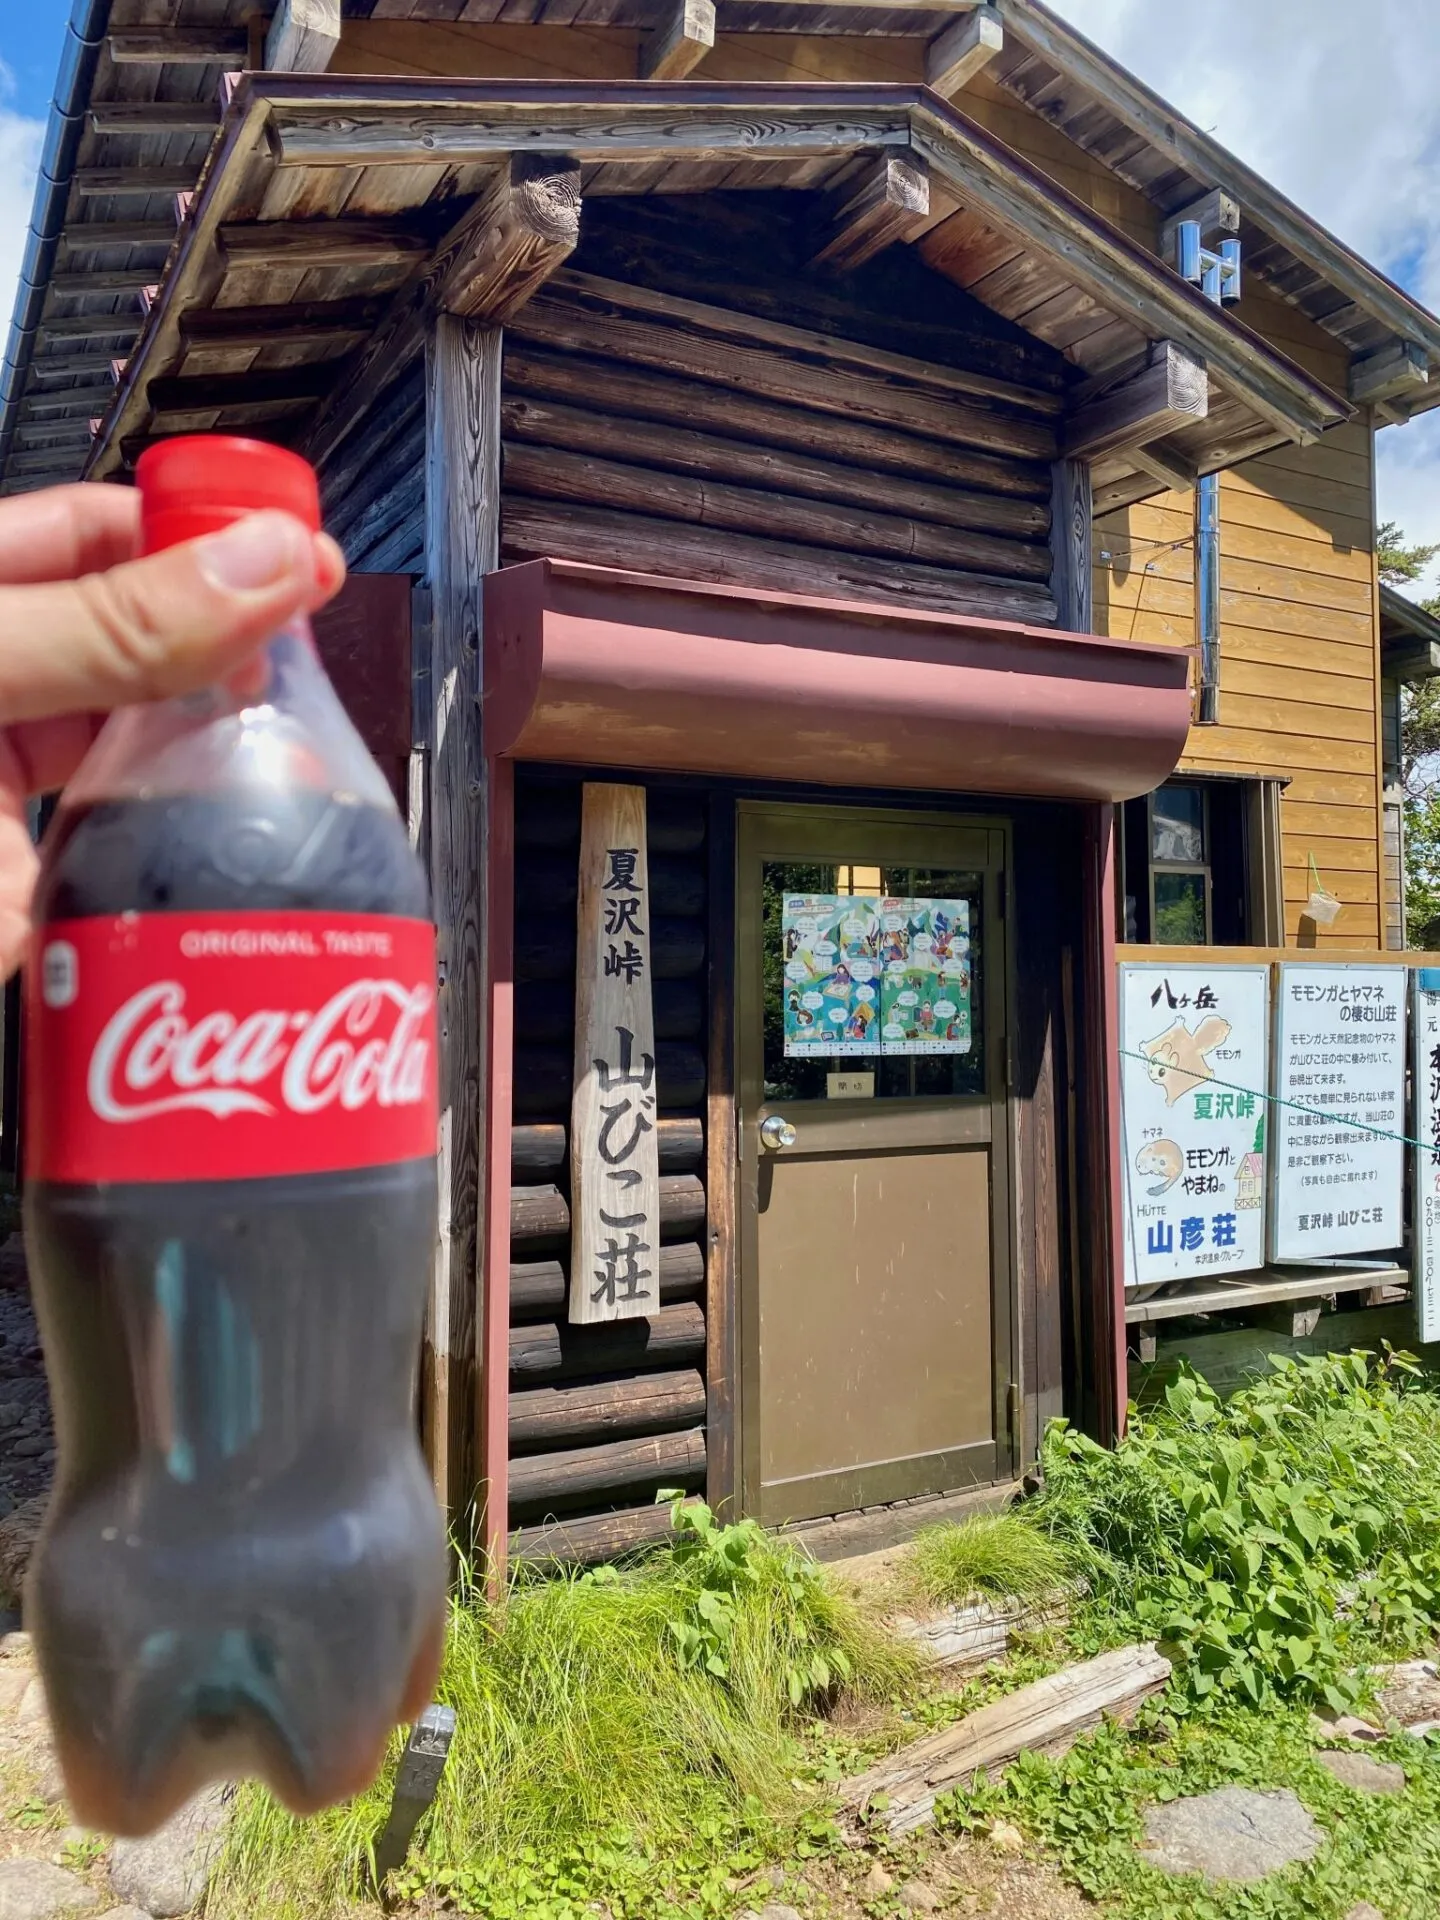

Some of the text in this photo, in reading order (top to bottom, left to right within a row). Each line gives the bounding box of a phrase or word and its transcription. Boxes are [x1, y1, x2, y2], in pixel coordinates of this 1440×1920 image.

[180, 930, 391, 957] ORIGINAL TASTE
[1291, 985, 1384, 1002] モモンガとヤマネ
[1340, 1005, 1397, 1022] の棲む山荘
[1290, 1033, 1396, 1045] モモンガと天然記念物のヤマネ
[87, 979, 433, 1123] Coca-Cola
[1216, 1049, 1241, 1060] モモンガ
[1289, 1052, 1393, 1066] が山びこ荘の中に棲み付いて、
[590, 847, 656, 1304] 夏沢峠 山びこ荘
[1289, 1073, 1346, 1086] 毎晩出て来ます。
[1193, 1093, 1255, 1120] 夏沢峠
[1142, 1127, 1164, 1138] ヤマネ
[1186, 1146, 1236, 1169] モモンガと
[1181, 1174, 1225, 1196] やまねの
[1298, 1207, 1383, 1231] 夏沢峠 山びこ荘
[1147, 1212, 1236, 1255] 山彦荘
